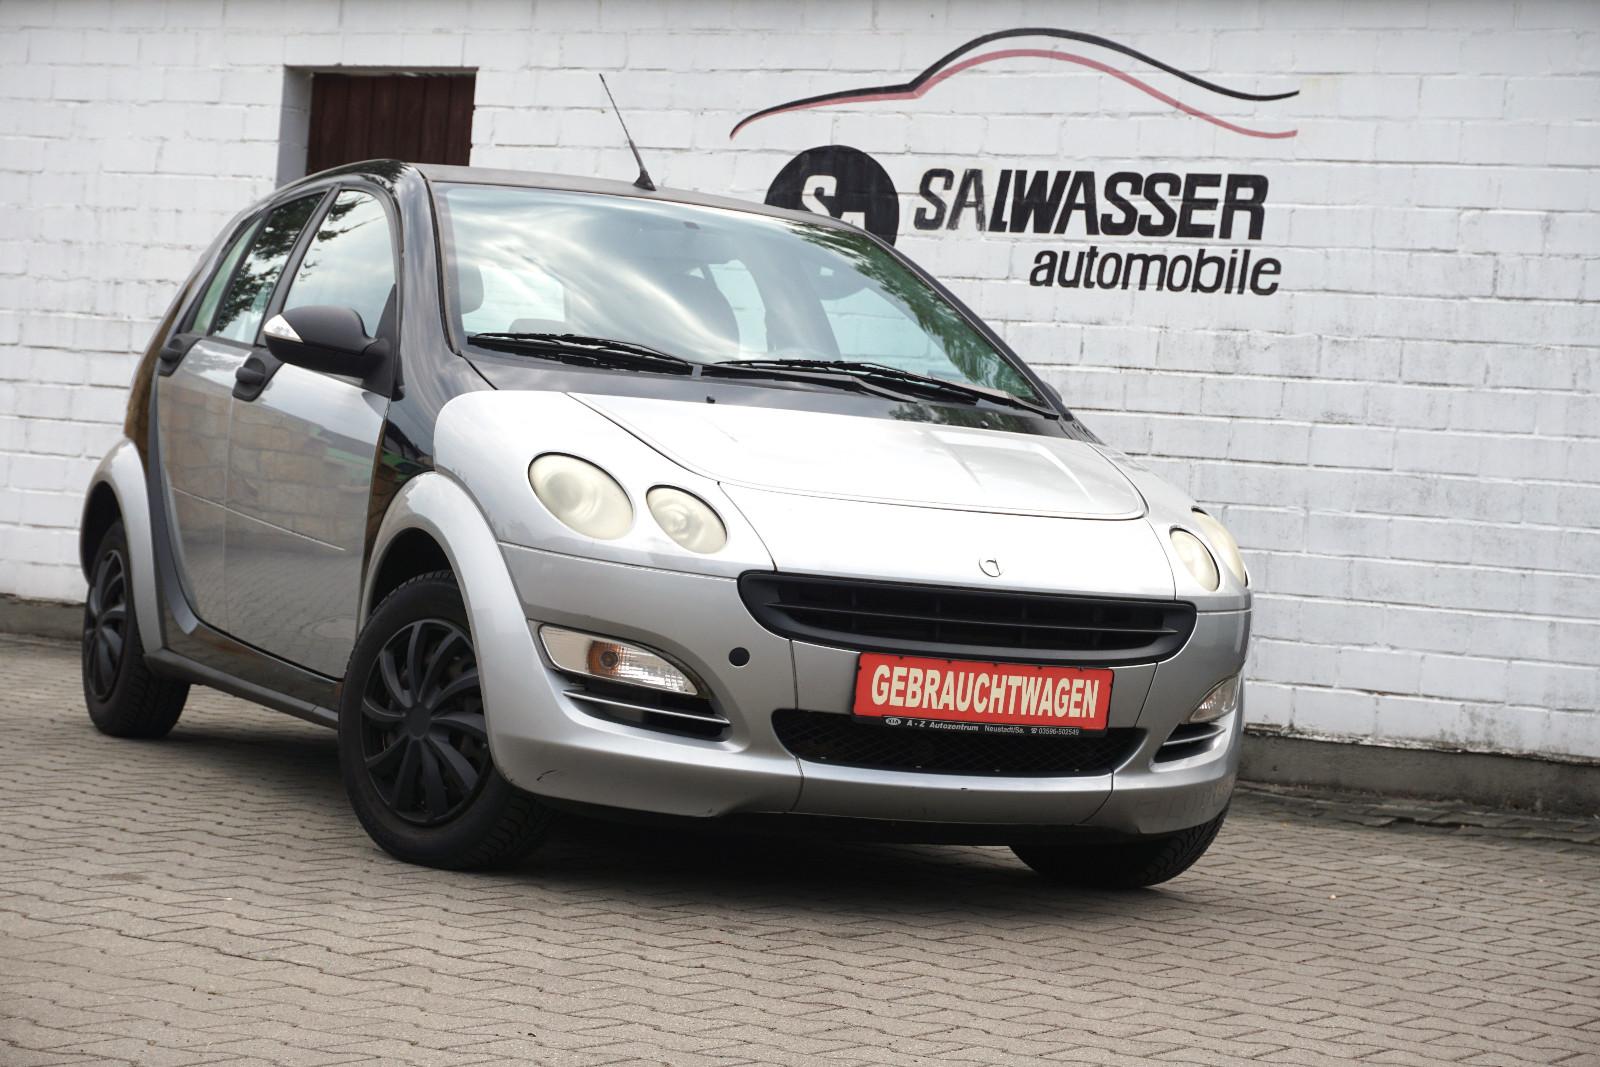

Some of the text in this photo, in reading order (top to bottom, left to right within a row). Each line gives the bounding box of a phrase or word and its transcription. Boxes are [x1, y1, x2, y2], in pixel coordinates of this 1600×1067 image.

[913, 167, 1270, 241] SALWASSER
[1029, 245, 1283, 296] automobile
[871, 664, 1100, 719] GEBRAUCHTWAGEN
[929, 721, 979, 732] Autozentrum
